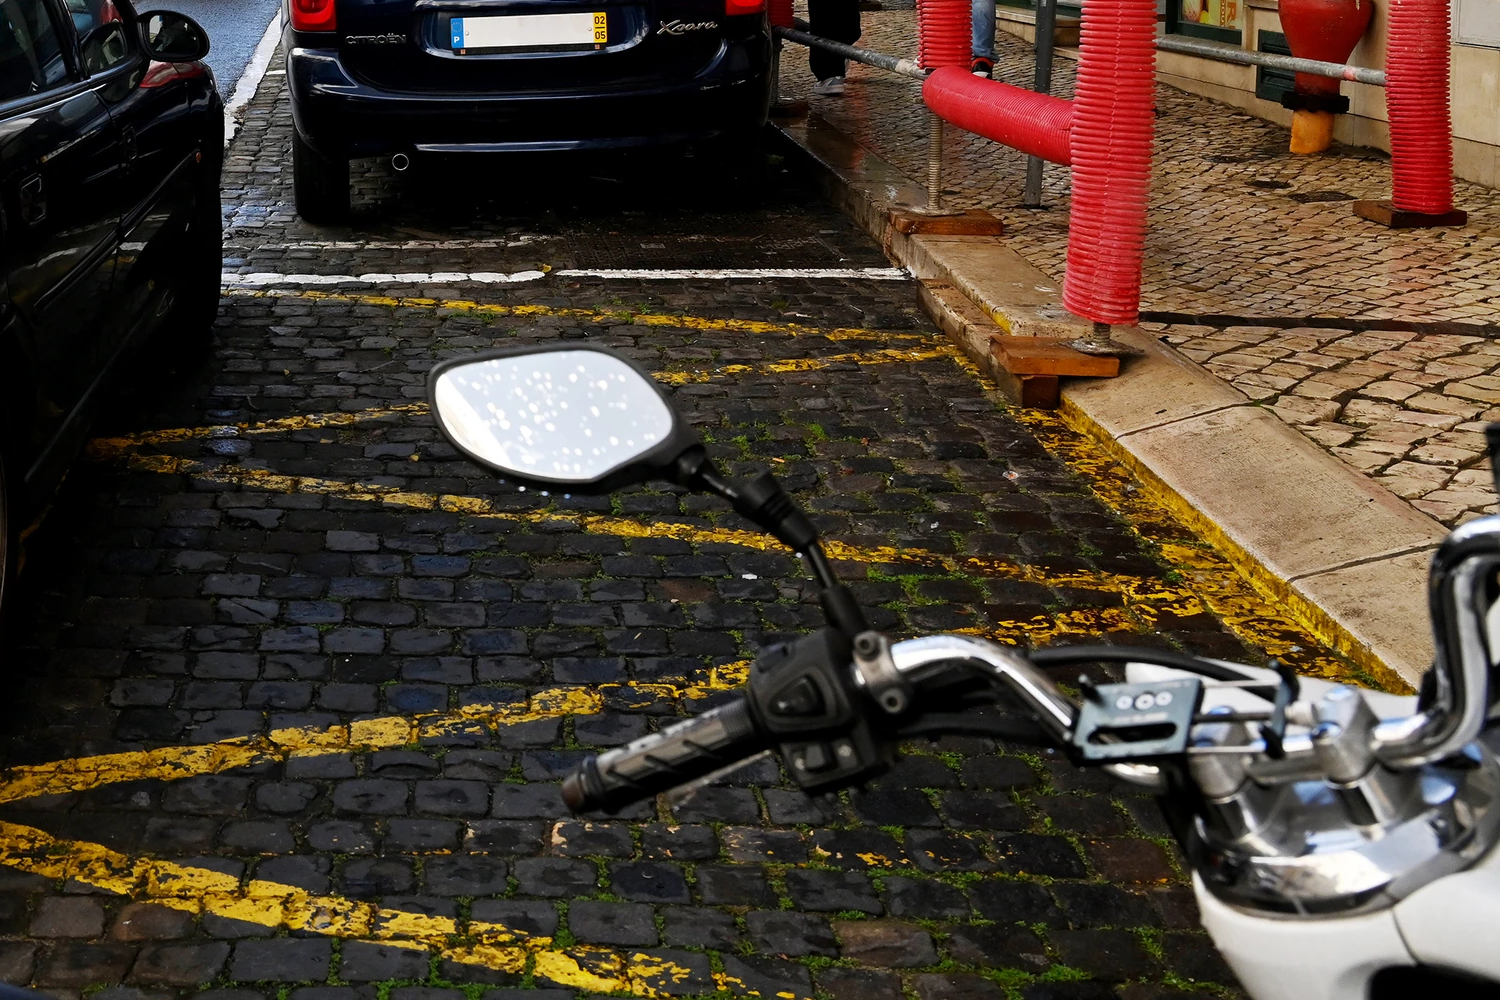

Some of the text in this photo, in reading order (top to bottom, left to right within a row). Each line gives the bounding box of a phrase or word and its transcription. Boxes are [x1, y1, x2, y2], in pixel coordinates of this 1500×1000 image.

[594, 16, 606, 25] 02
[656, 19, 719, 35] Xsara
[346, 33, 406, 45] CITROËN
[453, 36, 461, 44] P
[594, 30, 606, 40] 05
